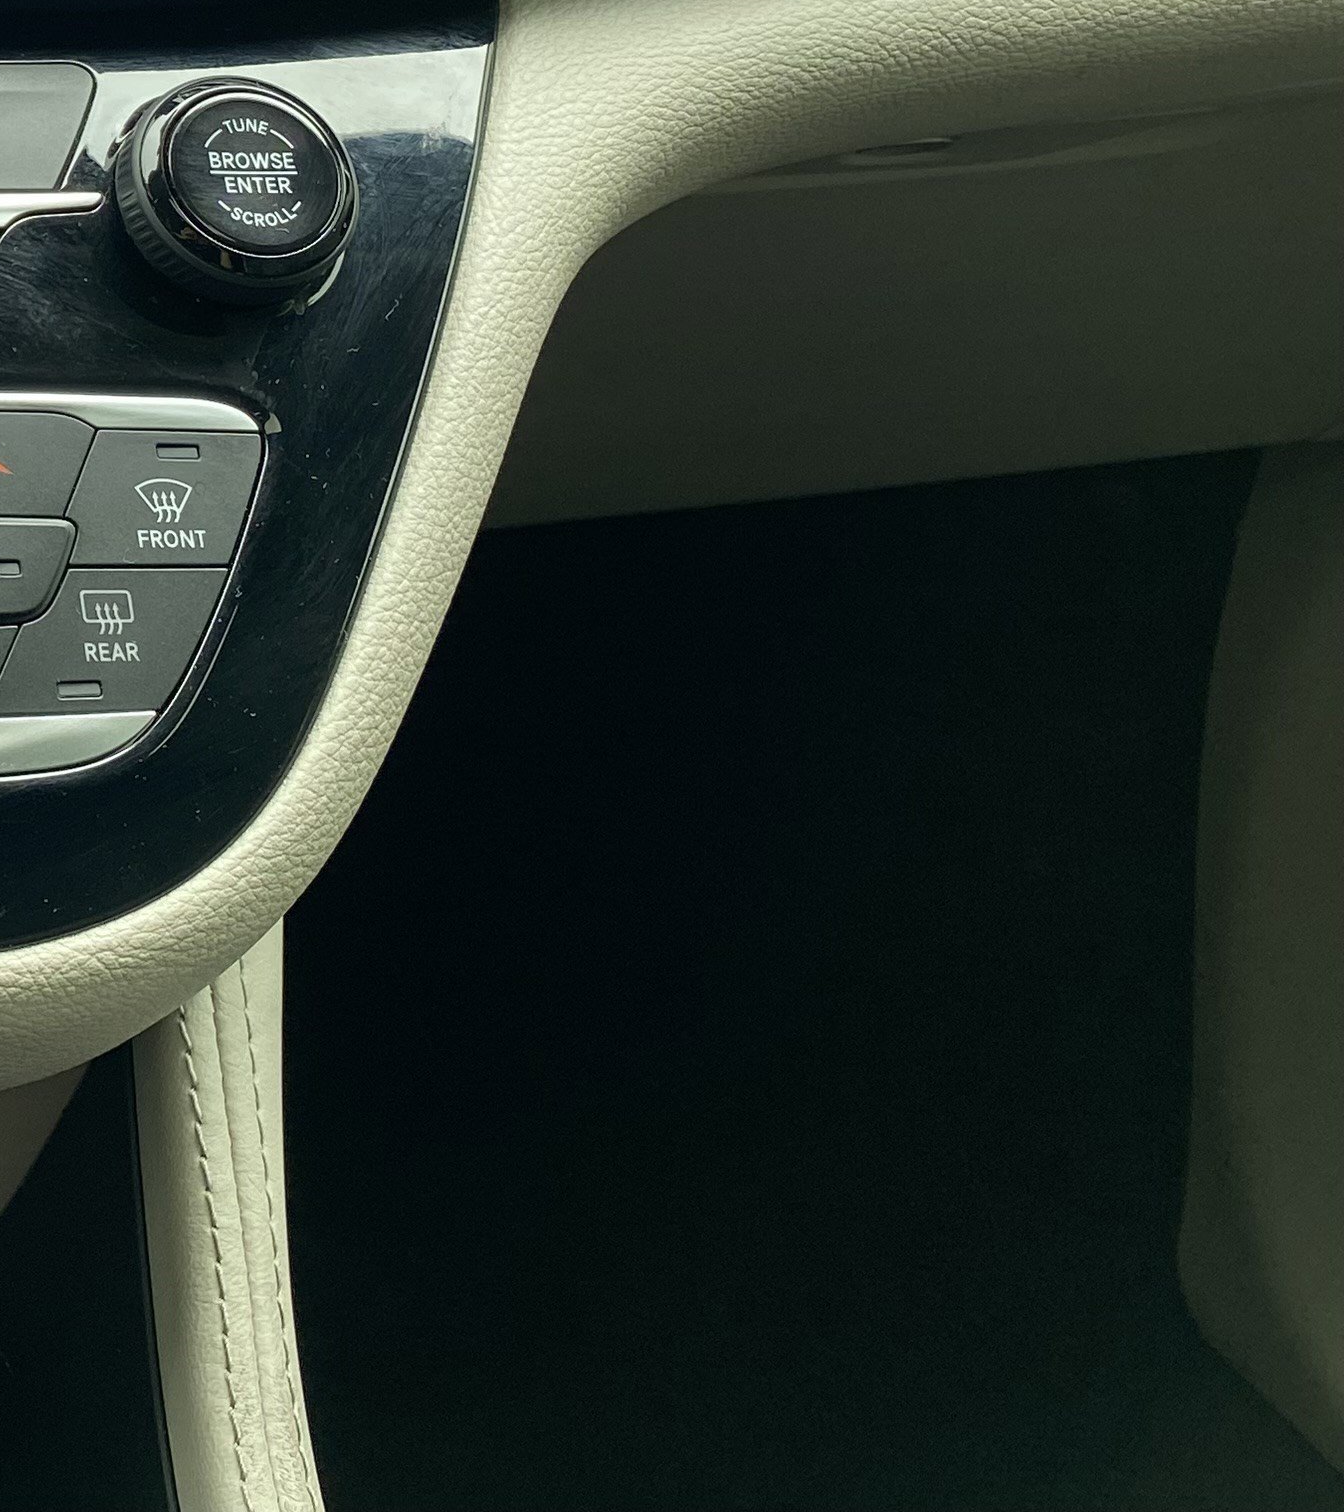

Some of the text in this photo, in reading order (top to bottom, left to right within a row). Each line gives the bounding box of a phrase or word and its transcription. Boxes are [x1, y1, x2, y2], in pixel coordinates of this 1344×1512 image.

[221, 118, 269, 135] TUNE
[208, 151, 295, 170] BROWSE
[224, 176, 293, 194] ENTER
[230, 207, 297, 227] SCROLL
[137, 530, 206, 549] FRONT
[84, 644, 140, 662] REAR
